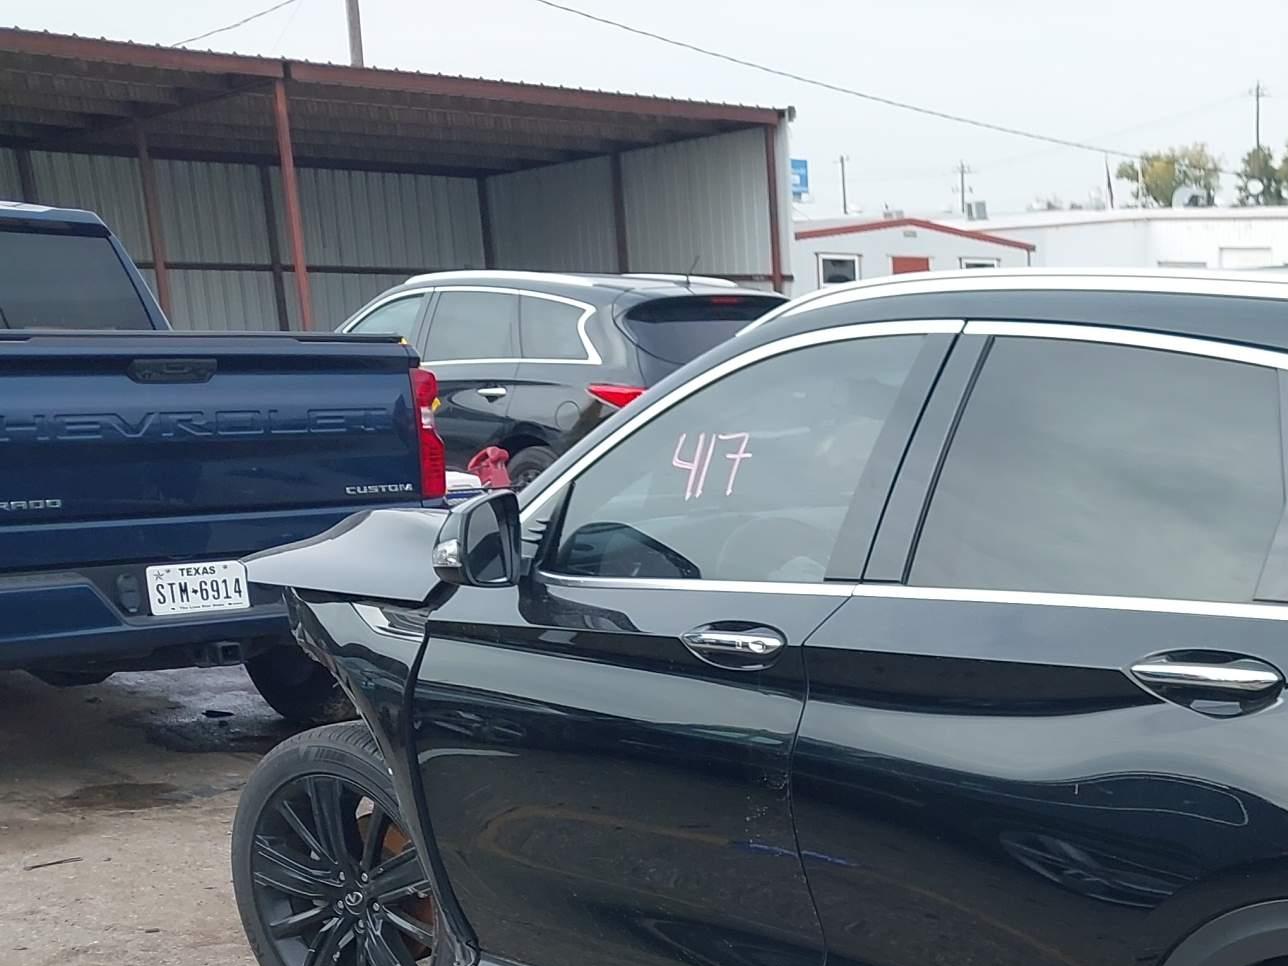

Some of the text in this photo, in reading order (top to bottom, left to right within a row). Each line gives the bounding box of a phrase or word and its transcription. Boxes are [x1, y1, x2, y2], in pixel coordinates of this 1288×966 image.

[672, 431, 753, 502] 417
[345, 482, 413, 495] CUSTOM
[178, 565, 216, 577] TEXAS
